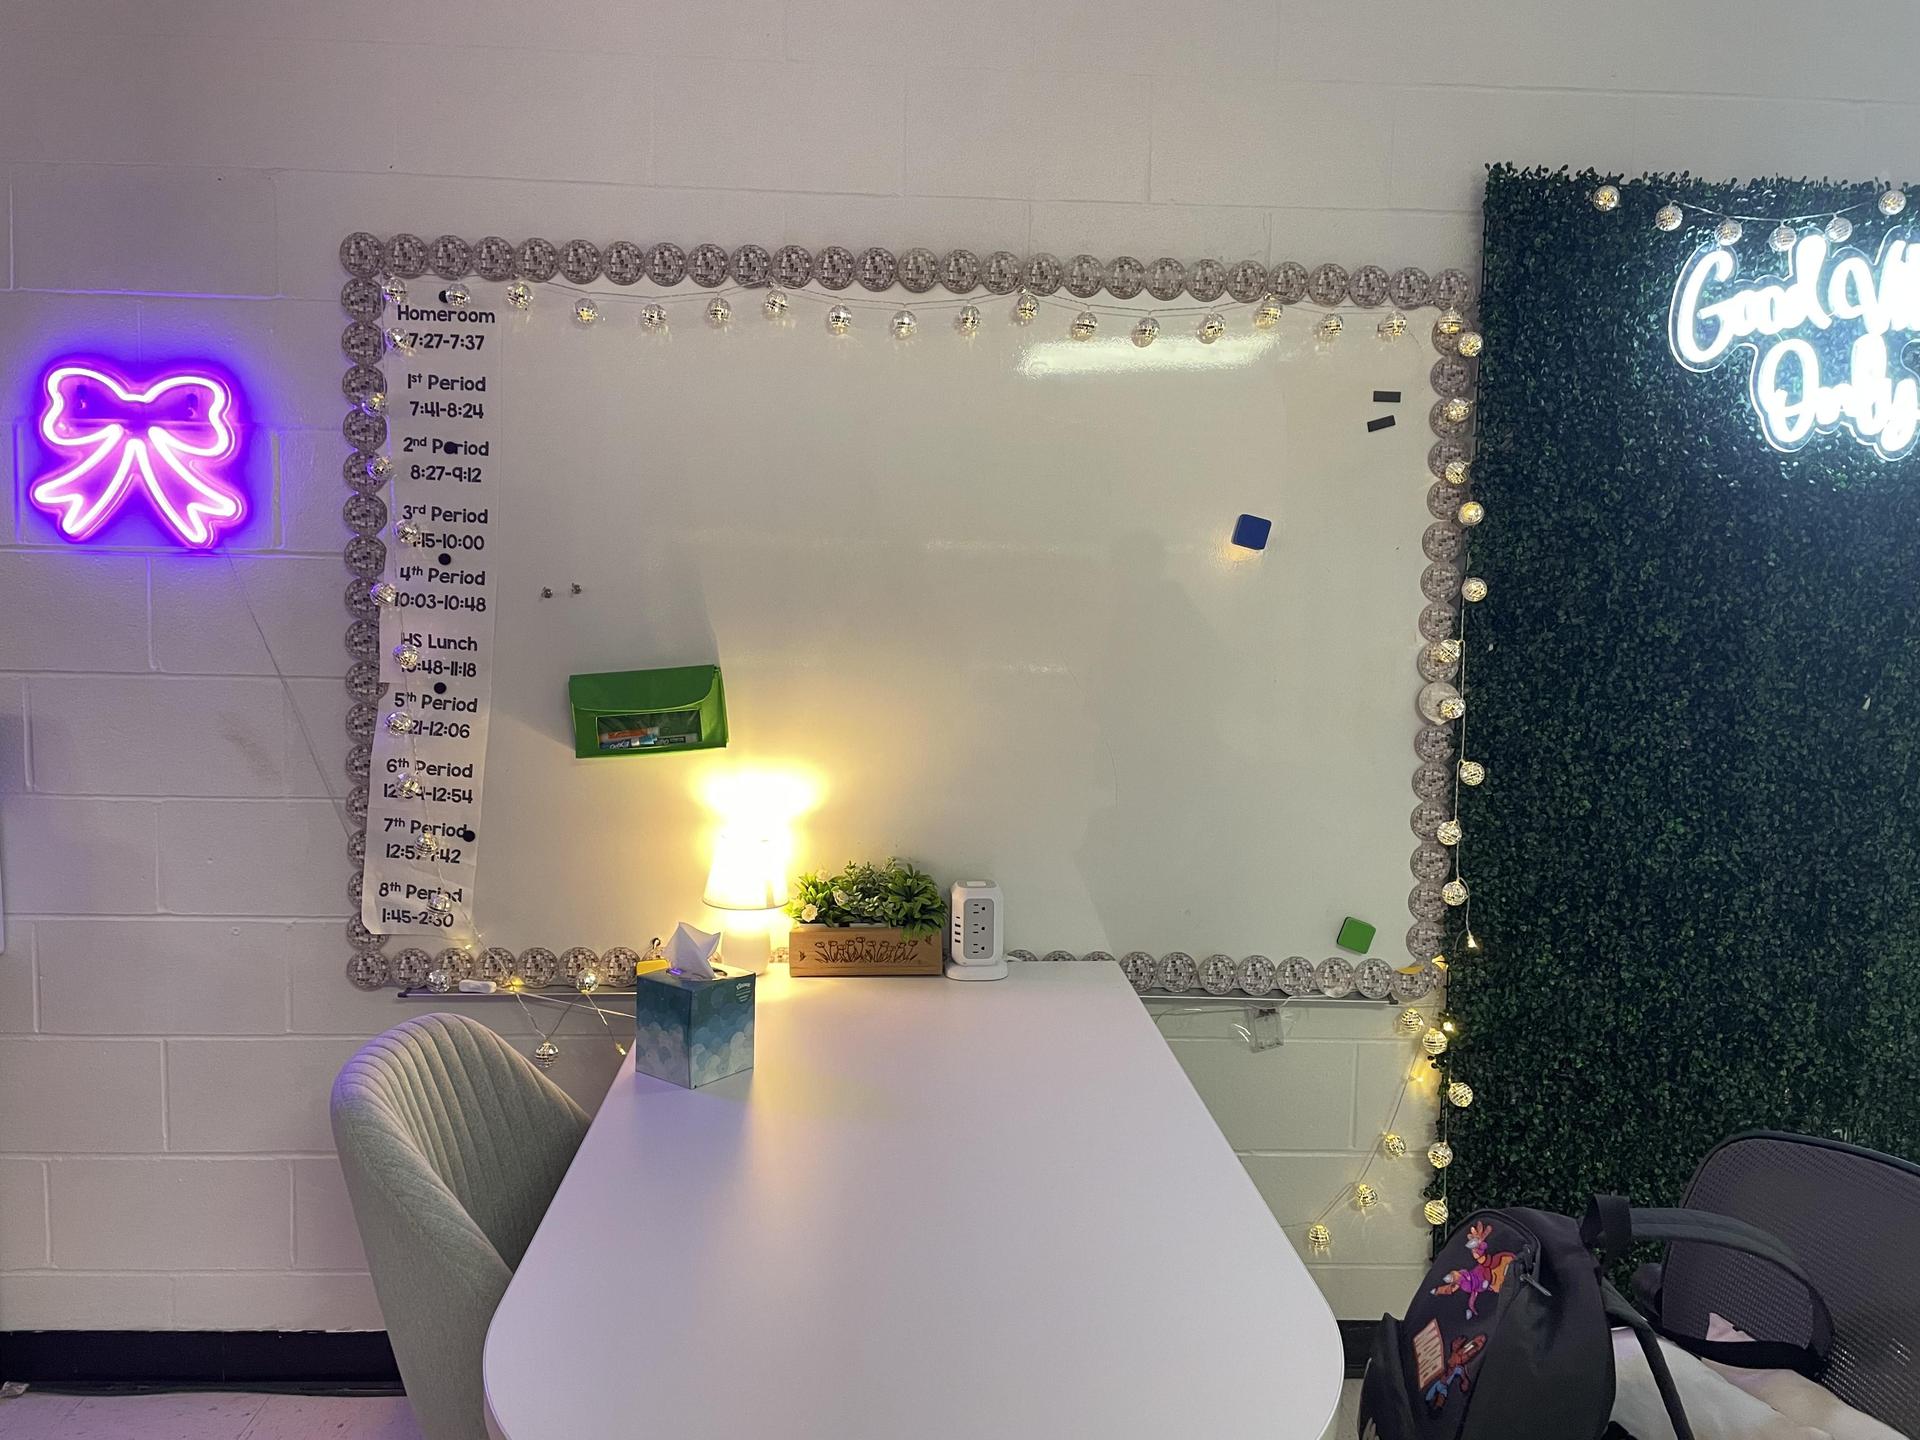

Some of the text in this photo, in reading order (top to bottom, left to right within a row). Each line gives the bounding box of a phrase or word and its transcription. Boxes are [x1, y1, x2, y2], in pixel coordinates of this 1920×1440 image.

[1676, 234, 1833, 363] Good
[397, 305, 496, 324] Homeroom
[408, 332, 486, 351] 7:27-7:37
[407, 373, 487, 392] 1st Period
[409, 401, 485, 420] 7:41-8:24
[403, 436, 490, 457] 2nd Priod
[410, 464, 482, 483] 8:27-9:12
[402, 504, 489, 524] 3rd Period
[411, 532, 485, 551] :15-10:00
[400, 566, 486, 586] 4th Period
[394, 591, 487, 612] 10:03-10:48
[400, 632, 478, 652] HS Lunch
[401, 659, 477, 678] :48-11:18
[394, 692, 478, 713] 5th Period
[386, 758, 474, 779] 6th Period
[383, 817, 468, 838] 7th Period
[378, 881, 401, 897] 8th
